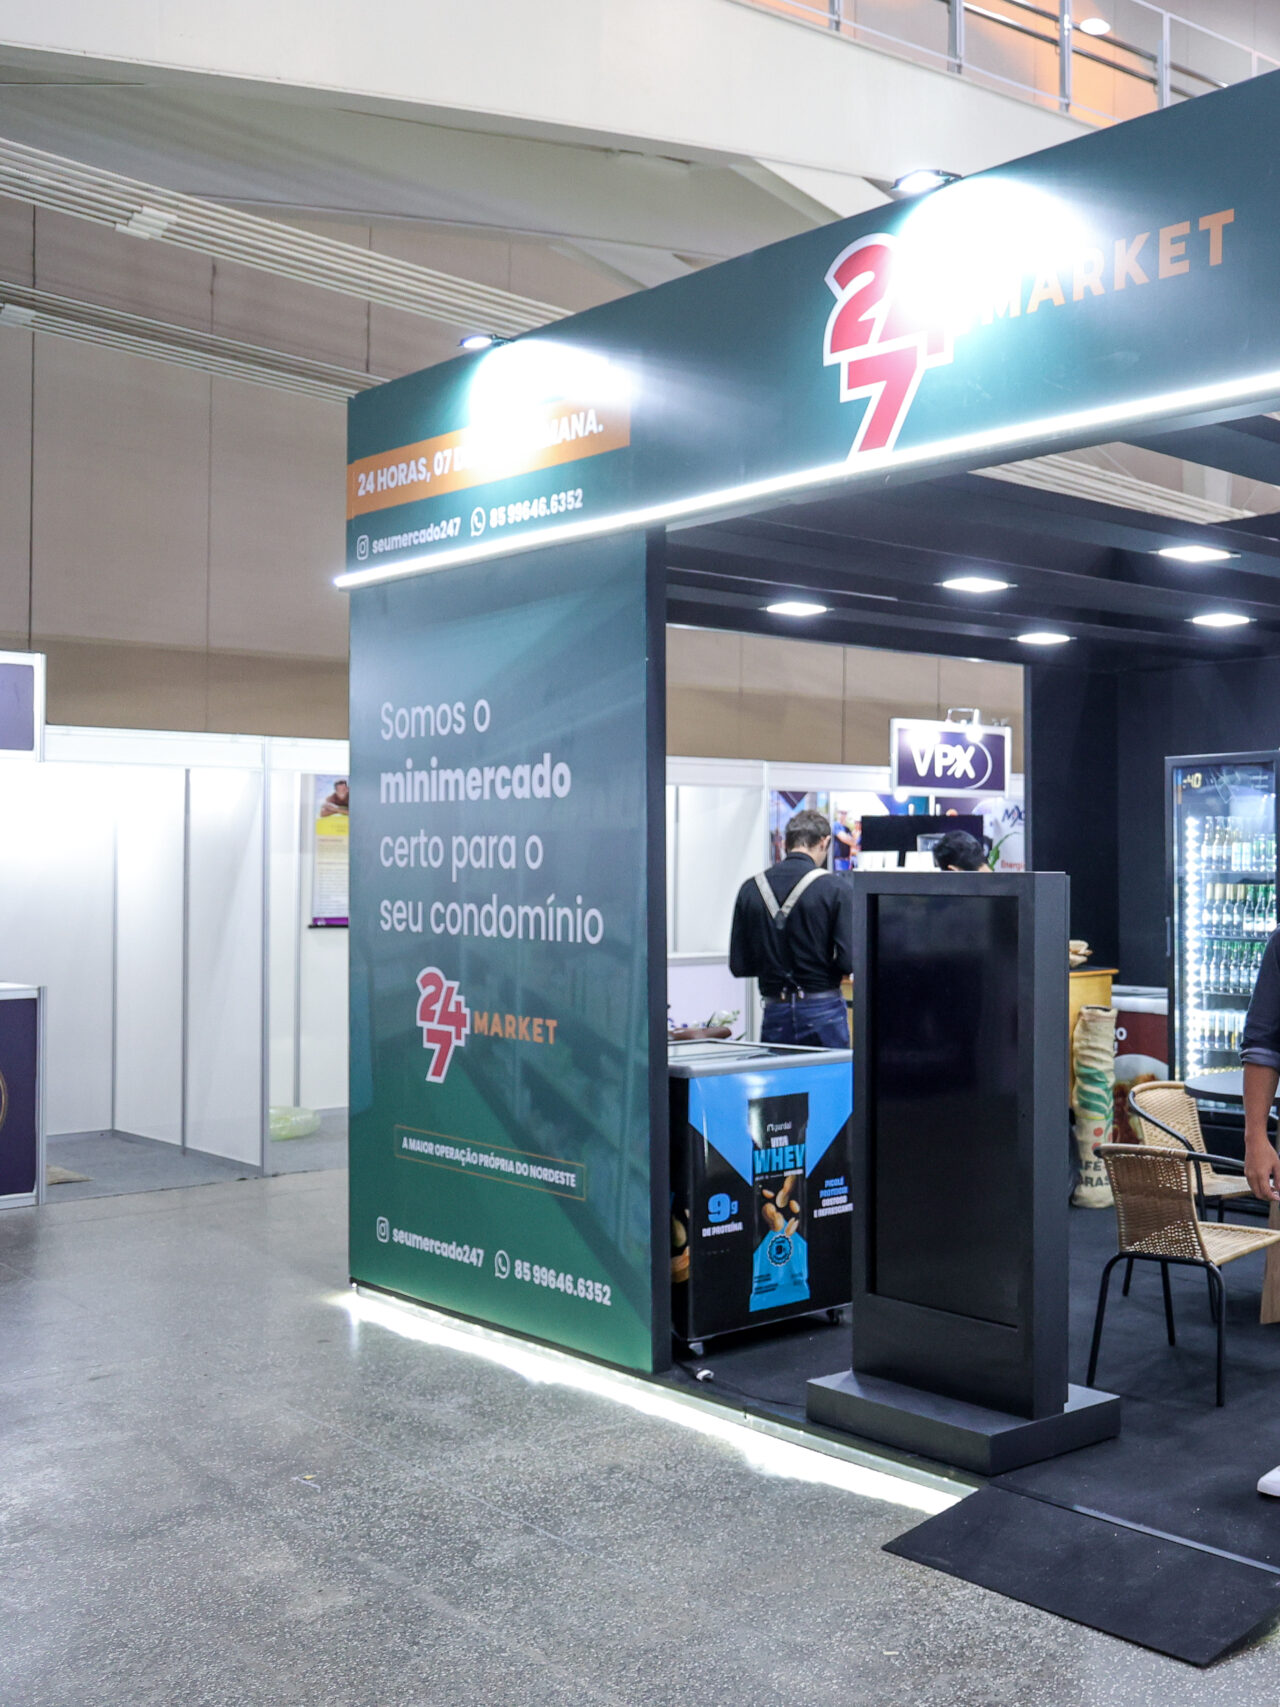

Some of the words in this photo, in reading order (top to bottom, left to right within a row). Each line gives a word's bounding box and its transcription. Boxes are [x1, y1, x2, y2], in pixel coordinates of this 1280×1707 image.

[357, 472, 376, 497] 24
[377, 457, 432, 492] HORAS,
[433, 448, 452, 476] 07
[372, 517, 461, 553] seumercado247
[489, 506, 506, 528] 85
[506, 488, 583, 525] 99646.6352
[380, 701, 467, 741] Somos
[473, 698, 491, 733] o
[380, 752, 572, 803] minimercado
[380, 829, 444, 868] certo
[451, 834, 516, 882] para
[525, 834, 543, 870] o
[380, 898, 423, 933] seu
[430, 893, 604, 944] condomínio
[474, 1010, 558, 1045] MARKET
[402, 1137, 409, 1150] A
[409, 1138, 434, 1153] MAIOR
[434, 1144, 478, 1167] OPERAÇÃO
[478, 1152, 515, 1174] PRÓPRIA
[515, 1161, 529, 1176] DO
[530, 1165, 577, 1188] NORDESTE
[753, 1144, 805, 1174] WHEY
[392, 1228, 484, 1268] seumercado247
[514, 1259, 531, 1282] 85
[533, 1263, 612, 1306] 99646.6352
